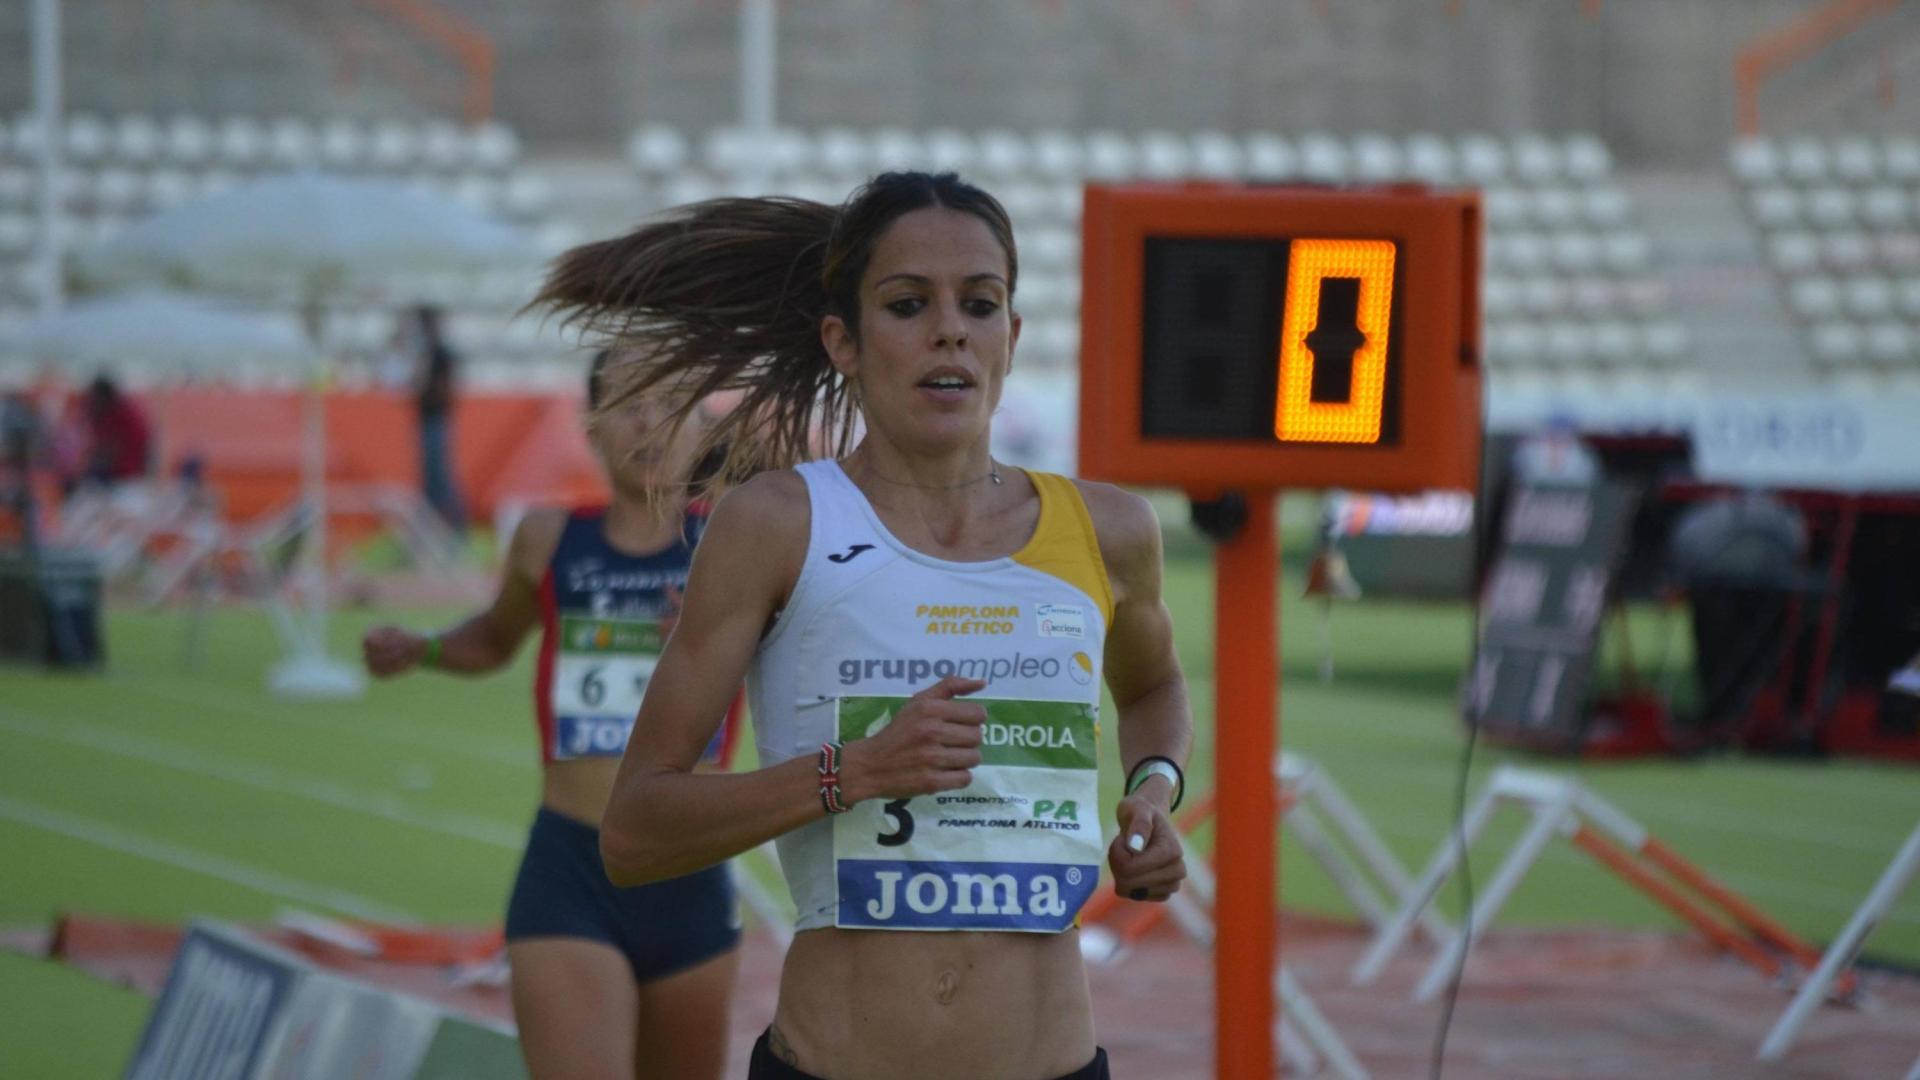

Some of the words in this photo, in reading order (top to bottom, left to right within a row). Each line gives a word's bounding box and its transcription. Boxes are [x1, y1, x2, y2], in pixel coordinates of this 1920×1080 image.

[1275, 239, 1396, 444] 0
[915, 605, 1020, 618] PAMPLONA
[838, 652, 1060, 685] grupompleo
[581, 664, 606, 708] 6
[876, 797, 915, 847] 3
[937, 819, 1018, 829] PAMPLONA
[1033, 800, 1078, 821] PA
